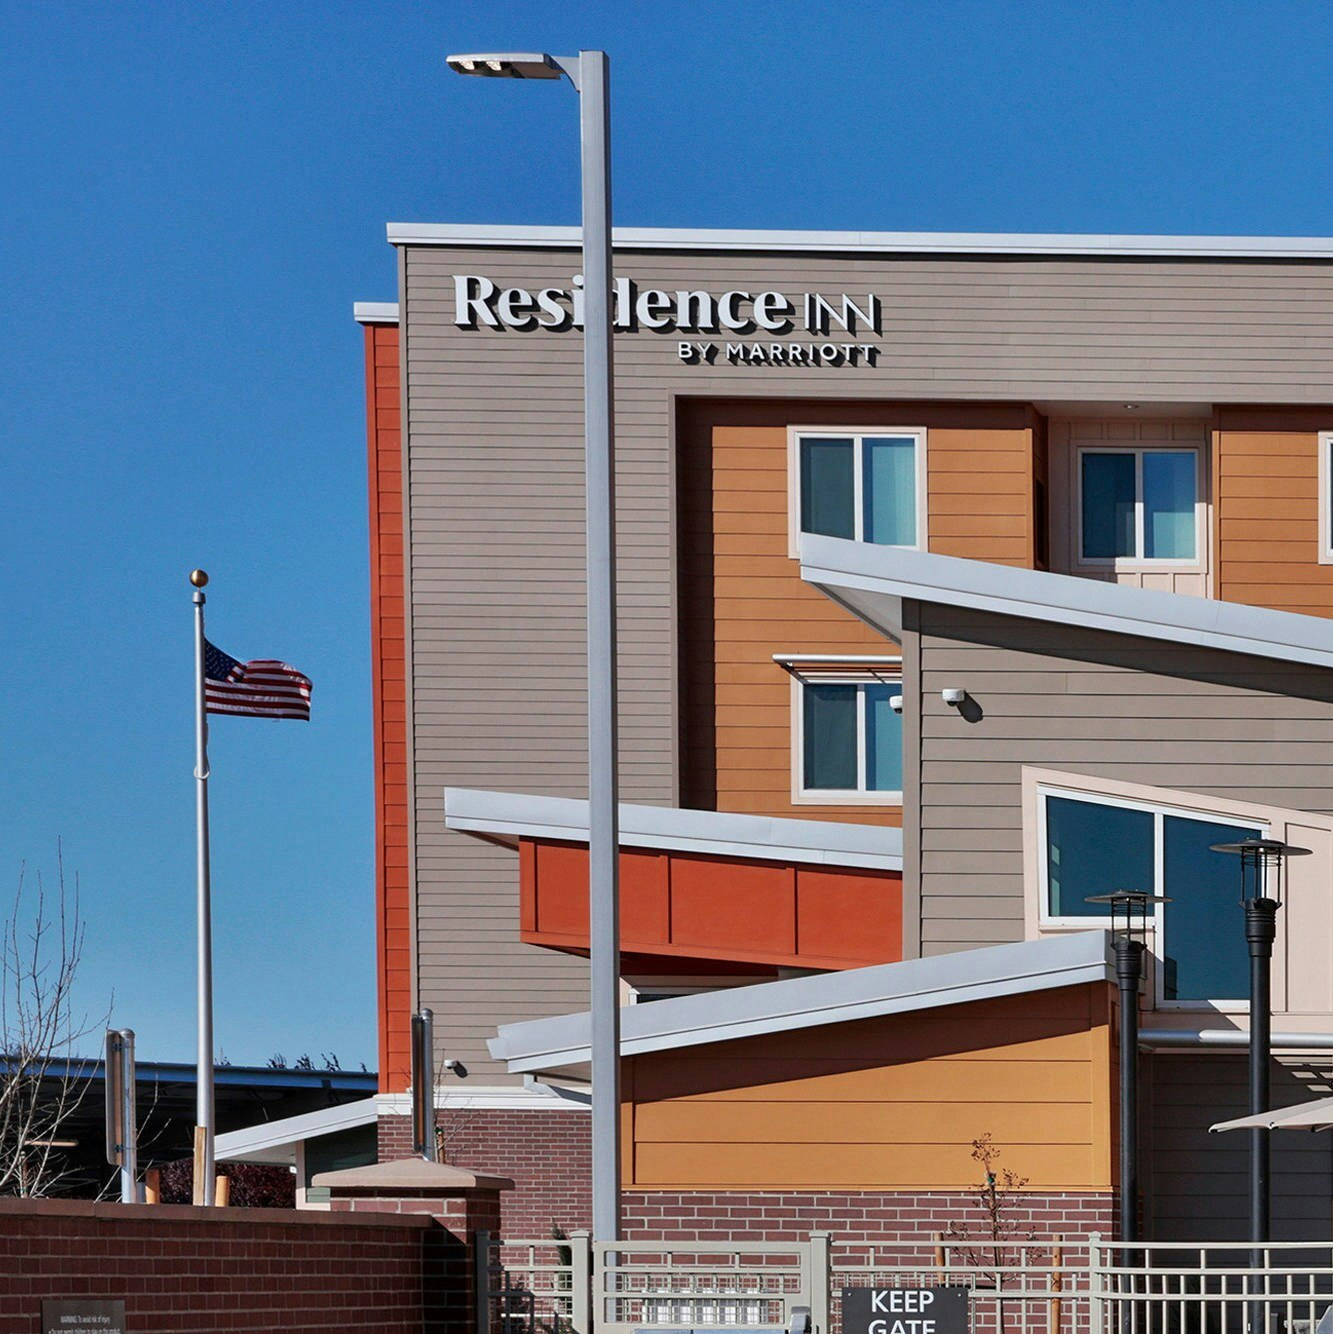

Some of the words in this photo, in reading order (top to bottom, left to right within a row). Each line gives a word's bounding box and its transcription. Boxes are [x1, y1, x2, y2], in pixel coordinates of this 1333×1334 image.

[804, 293, 876, 331] INN
[678, 341, 718, 360] BY
[727, 342, 875, 362] MARRIOTT
[871, 1290, 934, 1312] KEEP
